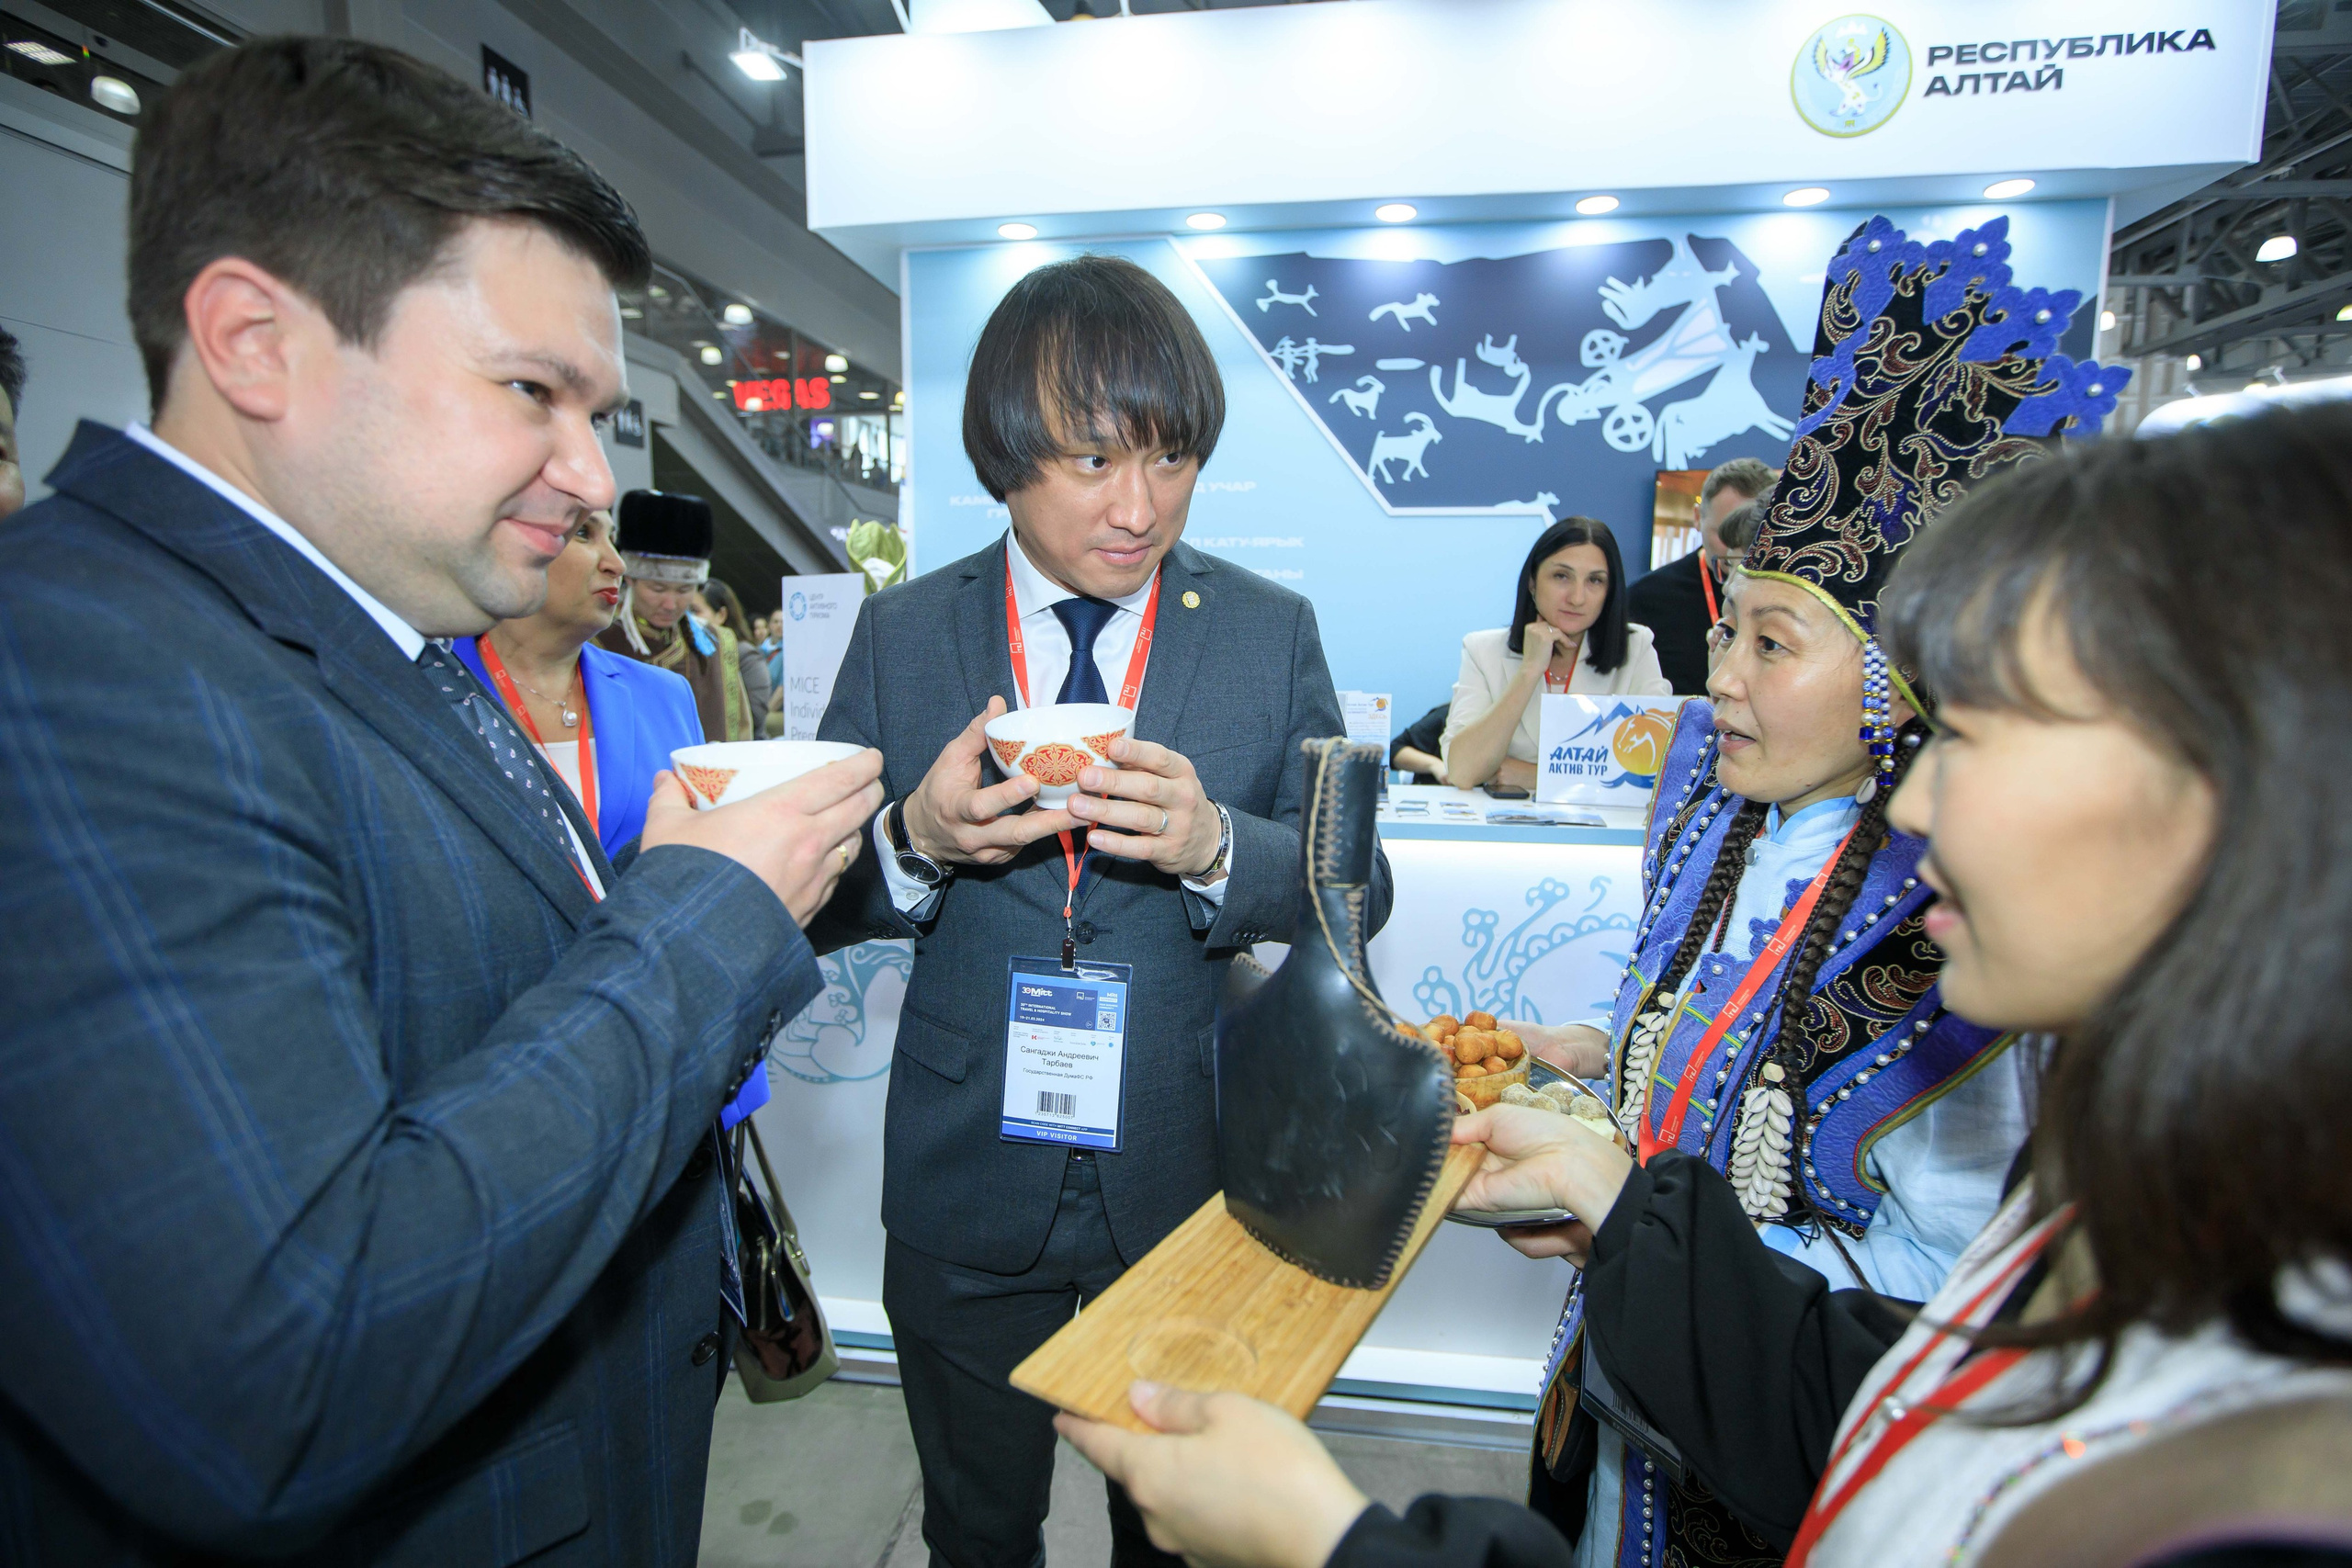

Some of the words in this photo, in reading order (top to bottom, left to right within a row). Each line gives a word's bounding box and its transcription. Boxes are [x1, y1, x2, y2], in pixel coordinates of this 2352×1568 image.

[1928, 28, 2216, 67] РЕСПУБЛИКА
[1923, 63, 2064, 97] АЛТАЙ
[790, 676, 820, 694] MICE
[1550, 746, 1609, 762] АЛТАЙ
[1549, 762, 1583, 774] АКТИВ
[1588, 764, 1608, 775] ТУР
[1021, 1045, 1056, 1056] Сангаджи
[1057, 1051, 1099, 1061] Андреевич
[1042, 1058, 1073, 1068] Тарбаев
[1050, 1132, 1078, 1141] VISITOR
